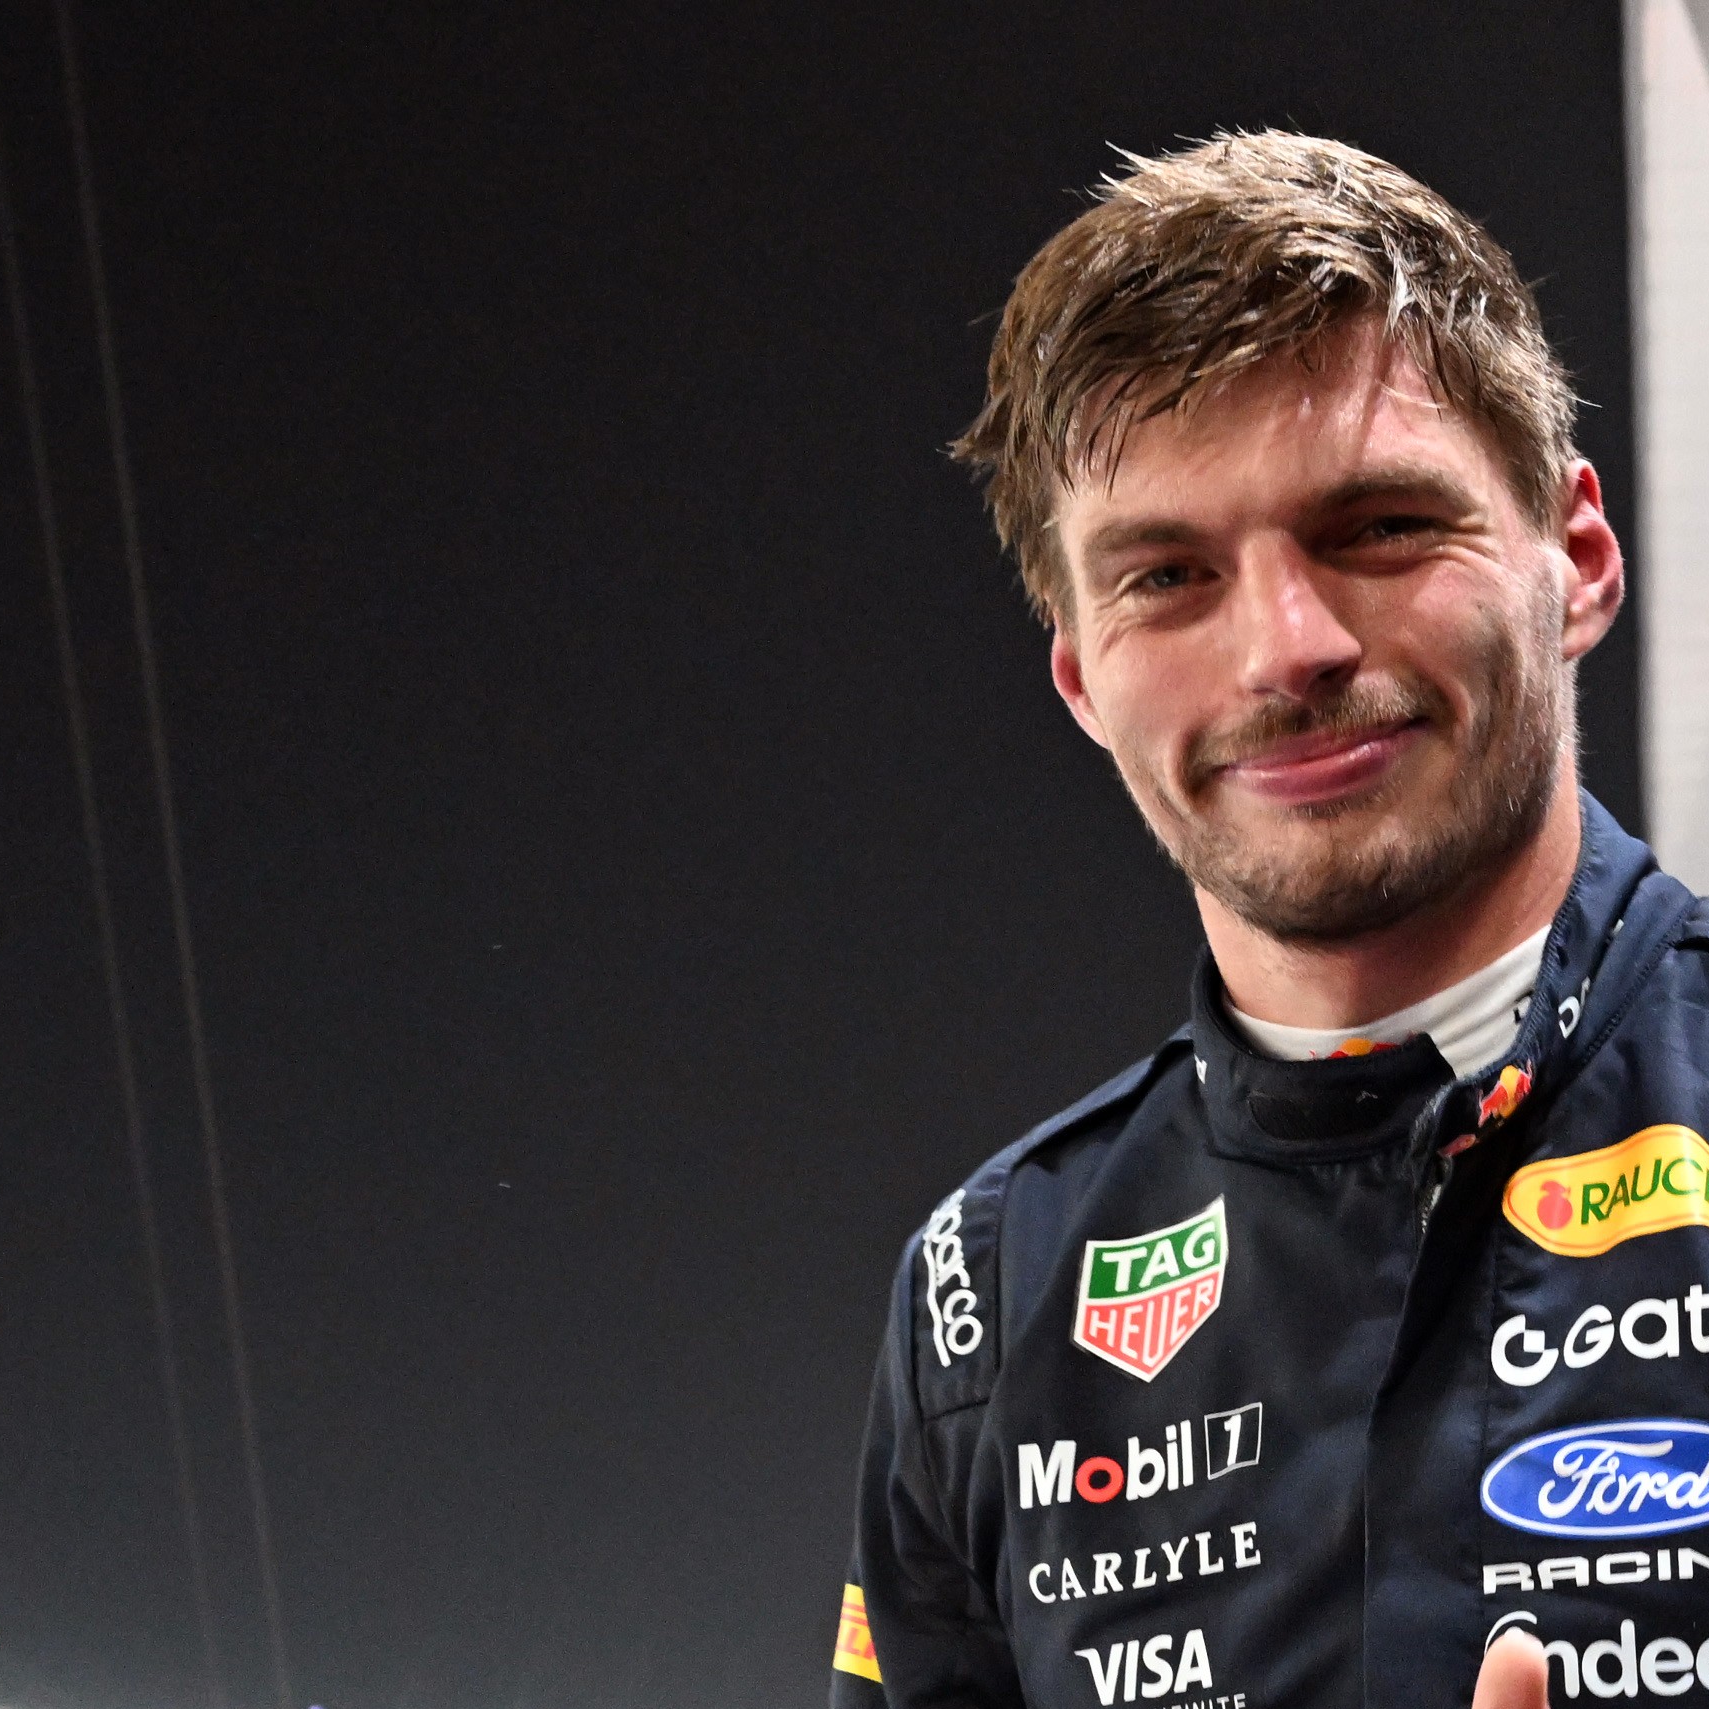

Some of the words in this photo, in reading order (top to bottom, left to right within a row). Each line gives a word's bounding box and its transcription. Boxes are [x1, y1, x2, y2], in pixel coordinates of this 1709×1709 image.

[1102, 1221, 1216, 1293] TAG
[1089, 1279, 1216, 1368] HEUER
[1018, 1419, 1194, 1510] Mobil
[1028, 1521, 1262, 1604] CARLYLE
[1074, 1628, 1213, 1707] VISA
